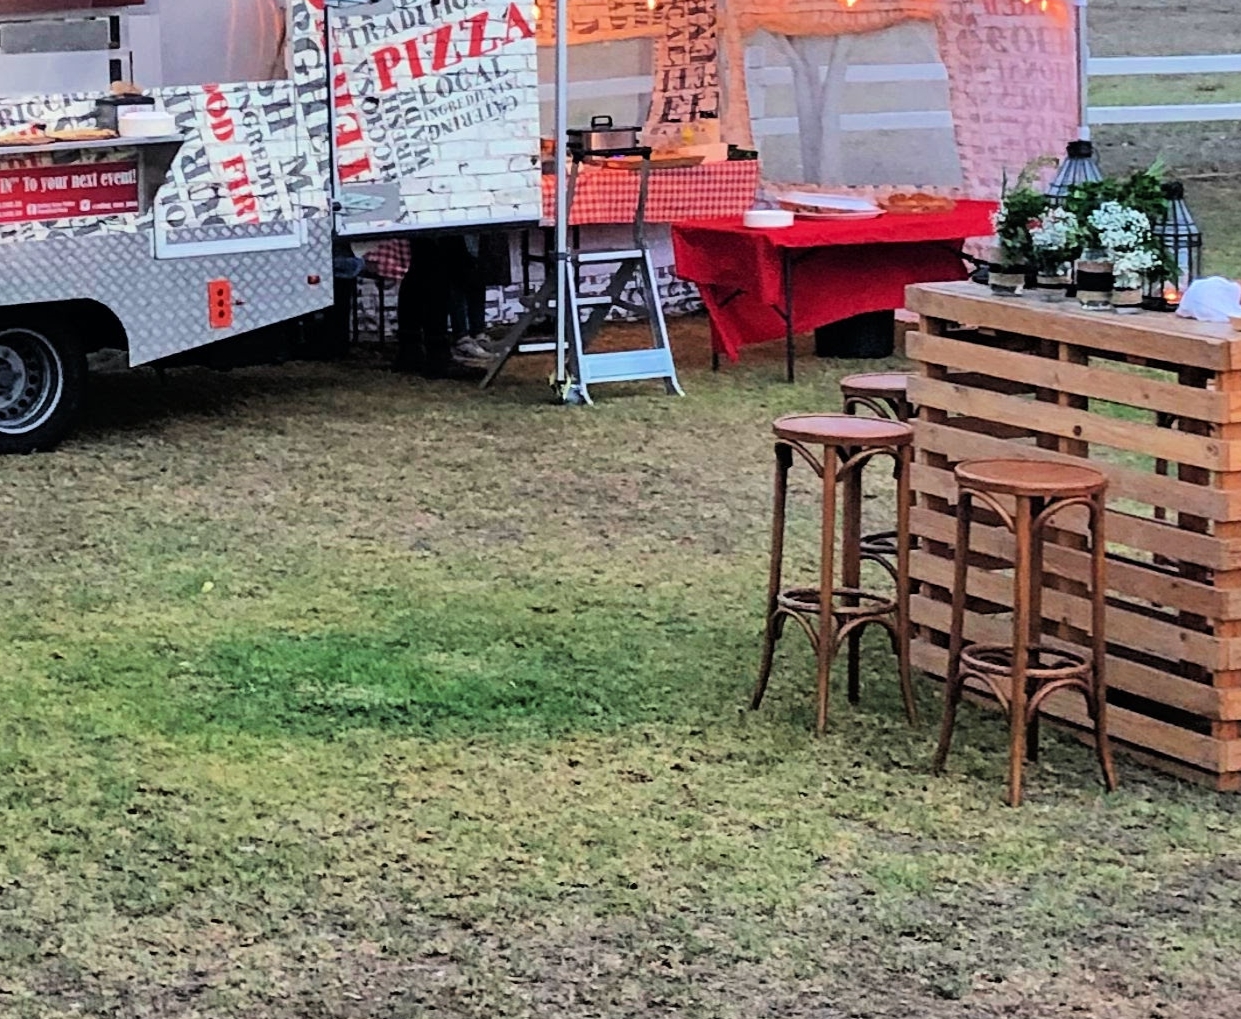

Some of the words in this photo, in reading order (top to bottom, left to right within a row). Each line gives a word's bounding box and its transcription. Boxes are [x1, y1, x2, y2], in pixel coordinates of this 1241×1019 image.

[372, 1, 536, 91] PIZZA
[419, 57, 509, 106] LOCAL
[428, 95, 518, 141] CATERING
[24, 176, 39, 193] To
[41, 175, 69, 193] your
[72, 174, 99, 188] next
[101, 169, 138, 186] event!
